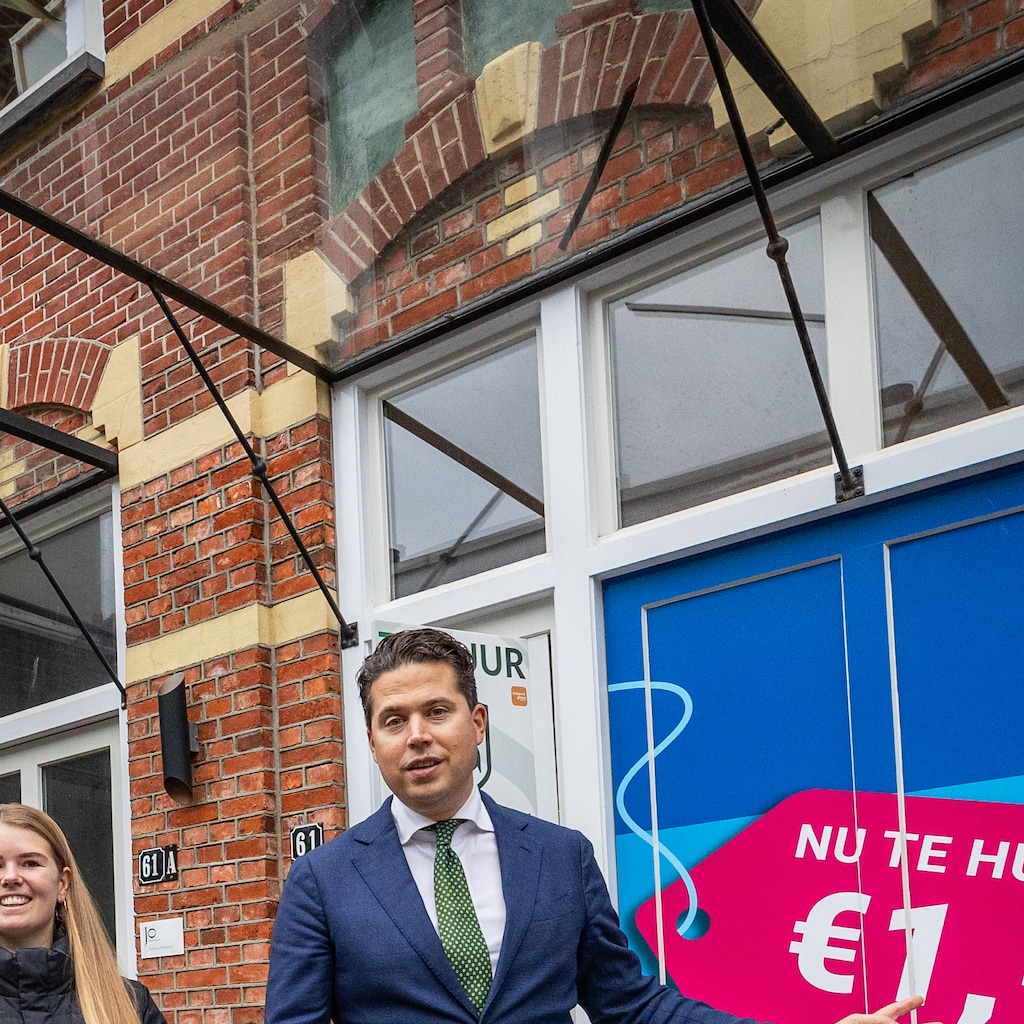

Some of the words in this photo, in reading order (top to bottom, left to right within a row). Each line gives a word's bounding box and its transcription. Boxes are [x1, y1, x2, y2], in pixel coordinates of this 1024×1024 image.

[295, 829, 316, 857] 61
[794, 823, 867, 864] NU
[883, 829, 954, 874] TE
[142, 853, 159, 879] 61
[166, 850, 178, 875] A
